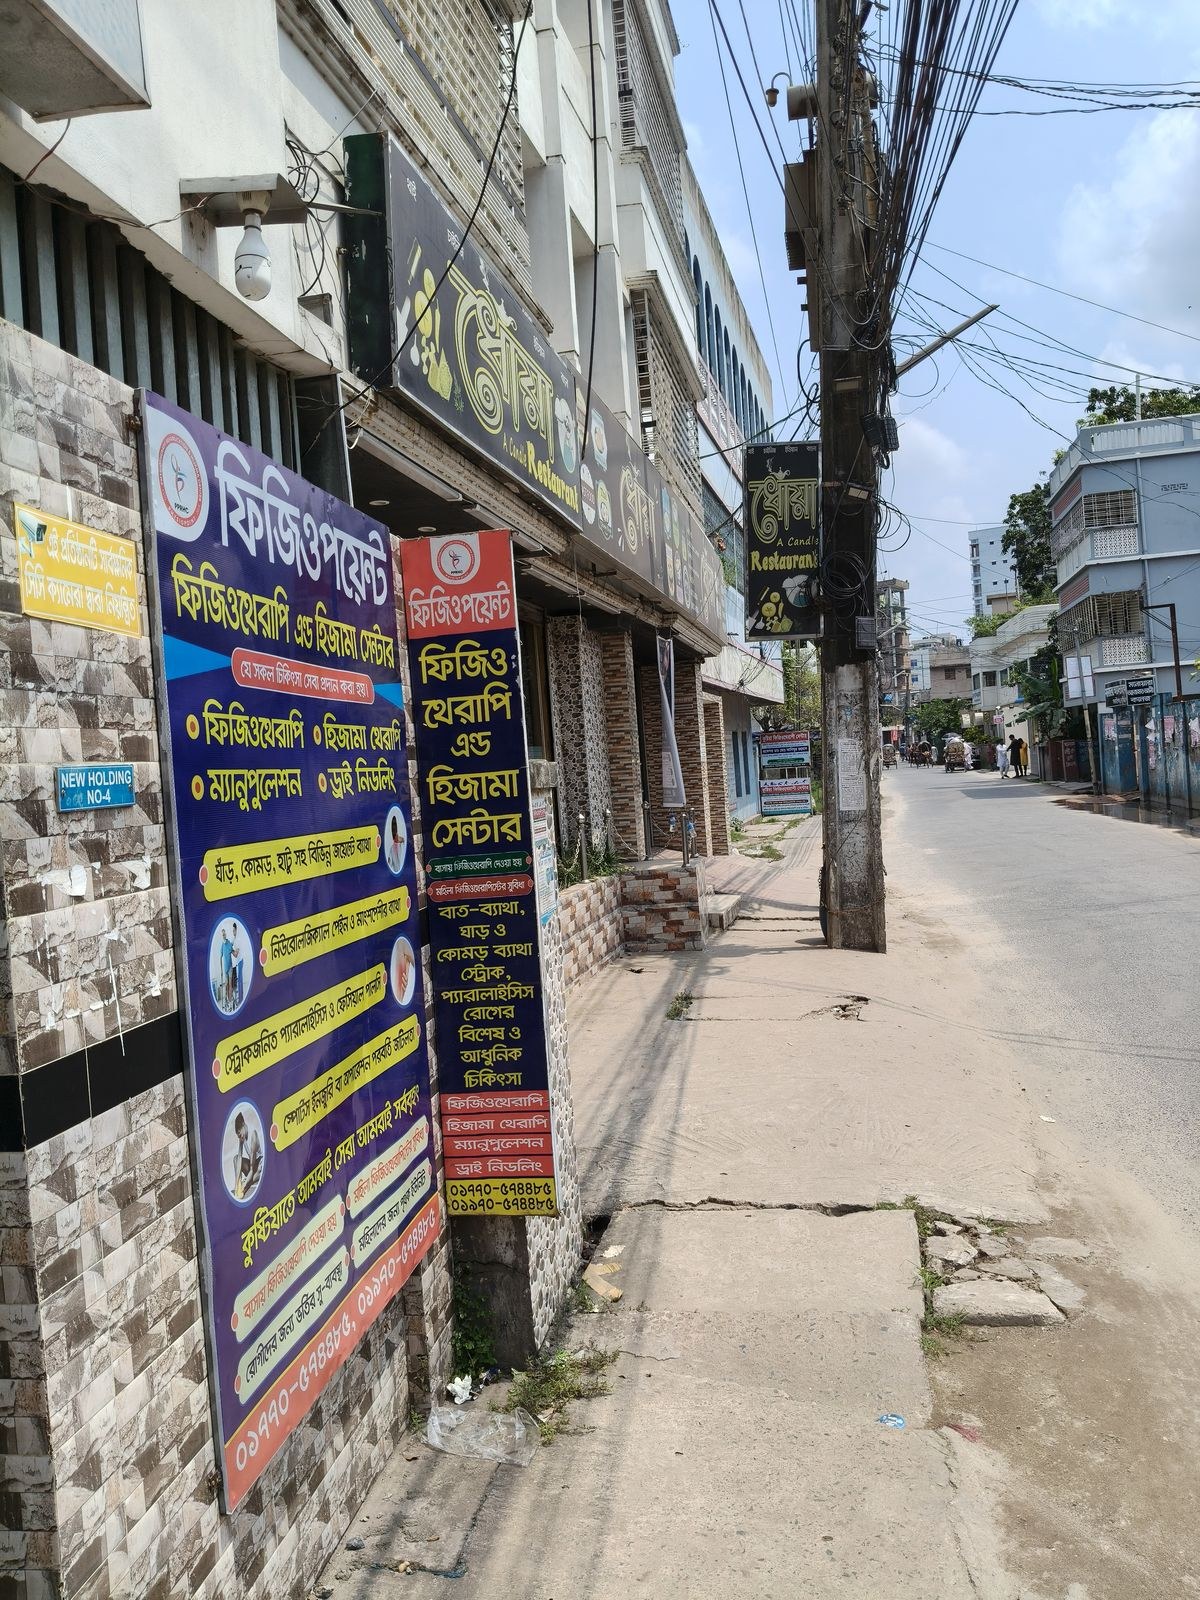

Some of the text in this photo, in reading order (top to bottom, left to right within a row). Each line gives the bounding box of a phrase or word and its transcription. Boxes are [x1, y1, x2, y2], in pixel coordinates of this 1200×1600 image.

[526, 440, 580, 514] Restaurant
[213, 440, 388, 606] ফিজিওপয়েন্ট
[776, 537, 784, 547] A
[24, 561, 45, 601] সিসি
[47, 577, 84, 610] ক্যামেরা
[171, 553, 290, 643] ফিজিওথেরাপি
[314, 601, 358, 660] হিজামা
[359, 624, 394, 669] সেন্টার
[409, 581, 511, 629] ফিজিওপয়েন্ট
[418, 639, 508, 685] ফিজিও
[240, 660, 252, 679] যে
[253, 662, 275, 683] সকল
[276, 661, 302, 687] চিকিৎসা
[303, 674, 320, 690] সেবা
[320, 676, 339, 693] প্রদান
[340, 680, 355, 694] করা
[422, 681, 512, 729] থেরাপি
[202, 698, 305, 749] ফিজিওথেরাপি
[323, 712, 402, 752] হিজামা থেরাপি
[61, 770, 132, 788] NEW HOLDING
[207, 768, 303, 812] ম্যানুপুলেশন
[328, 757, 397, 800] ড্রাই নিডলিং
[426, 764, 520, 805] হিজামা
[87, 788, 111, 805] NO-4
[432, 808, 522, 848] সেন্টার
[294, 850, 308, 867] সহ
[308, 840, 332, 867] বিভিন্ন
[331, 915, 349, 938] পেইন
[349, 916, 355, 930] ও
[459, 923, 507, 940] ঘাড় ও
[437, 945, 489, 962] কোমড়
[441, 981, 534, 1004] প্যারালাইসিস
[328, 1002, 335, 1018] ও
[463, 1004, 515, 1022] রোগের
[458, 1023, 522, 1043] বিশেষ ও
[460, 1044, 522, 1066] আধুনিক
[335, 1076, 342, 1093] বা
[463, 1067, 522, 1088] চিকিৎসা
[446, 1093, 544, 1111] ফিজিওথেরাপি
[446, 1115, 548, 1132] হিজামা থেরাপি
[454, 1137, 544, 1153] ম্যানুপুলেশন
[455, 1158, 543, 1177] ড্রাই নিডলিং
[240, 1186, 296, 1269] কুষ্টিয়াতে
[297, 1148, 333, 1204] আমরাই
[333, 1132, 356, 1170] সেরা
[356, 1100, 394, 1148] আমরাই
[450, 1182, 552, 1198] ০১৭৭০-৫৭৪৪৮৫
[451, 1196, 555, 1211] ০১৯৭০-৫৭৪৪৮৫
[357, 1209, 436, 1317] ০১৯৭০-৫৭৪৪৮৫
[244, 1332, 279, 1385] রোগীদের
[278, 1319, 295, 1349] জন্য
